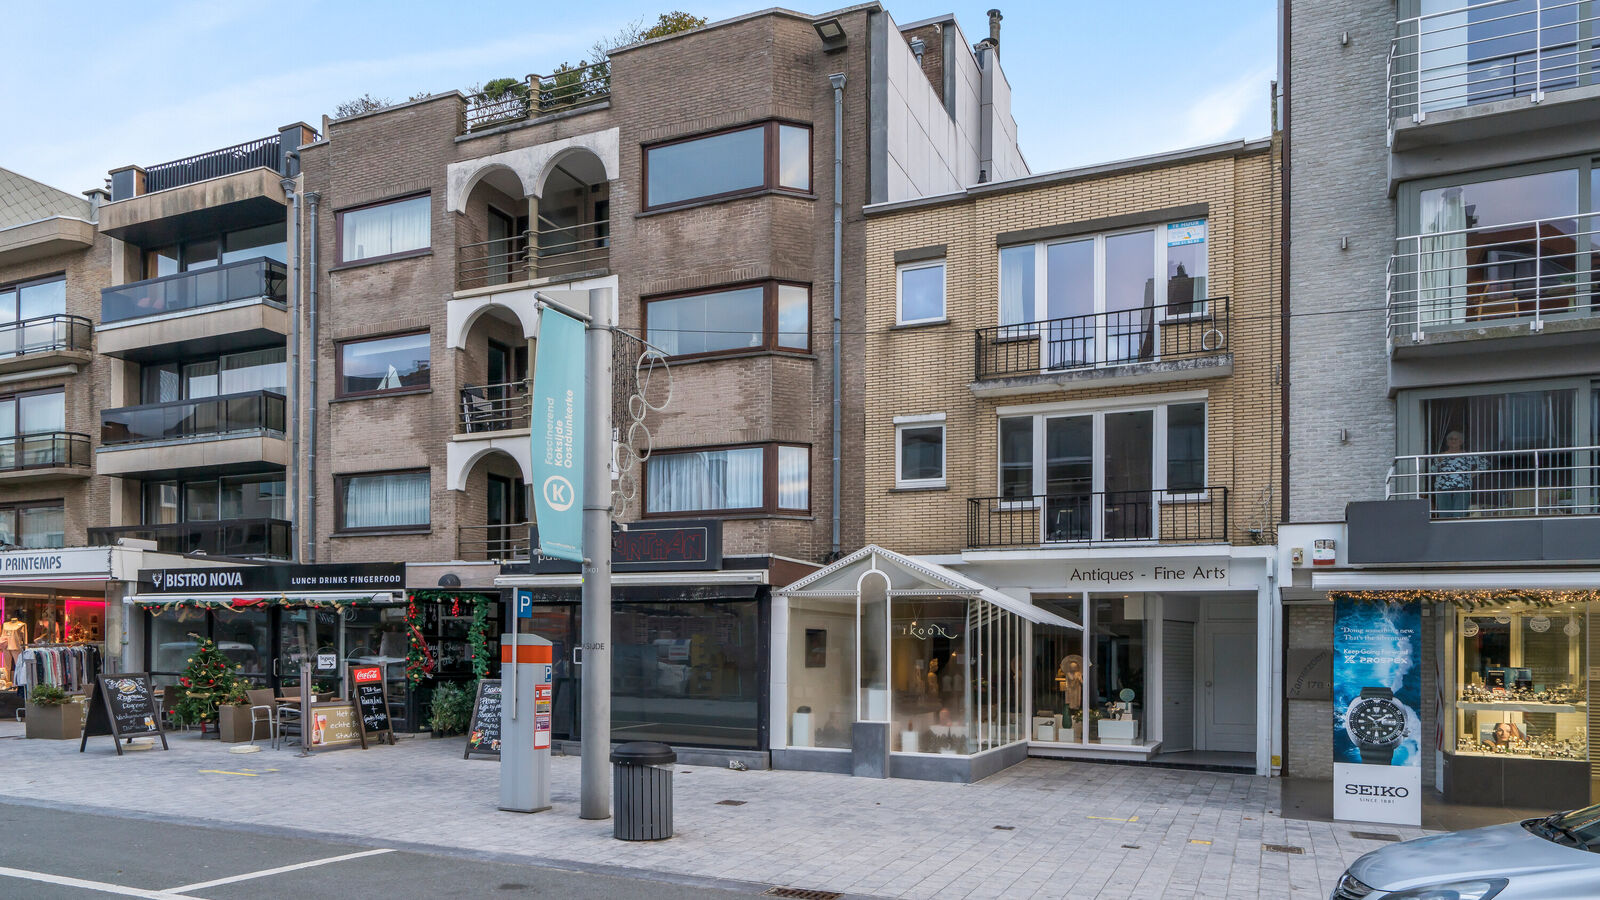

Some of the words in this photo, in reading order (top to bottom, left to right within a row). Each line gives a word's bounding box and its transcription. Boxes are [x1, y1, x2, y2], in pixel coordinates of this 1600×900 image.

[563, 389, 574, 469] Oostduinkerke
[553, 419, 565, 468] Koksijde
[552, 483, 566, 503] K
[5, 556, 62, 571] PRINTEMPS
[166, 573, 207, 587] BISTRO
[209, 572, 243, 586] NOVA
[291, 577, 317, 585] LUNCH
[319, 576, 348, 584] DRINKS
[350, 575, 401, 584] FINGERFOOD
[1070, 568, 1134, 584] Antiques
[1154, 566, 1186, 580] Fine
[1192, 566, 1226, 580] Arts
[520, 595, 531, 614] P
[1343, 648, 1360, 656] Keep
[1360, 648, 1382, 656] Going
[545, 666, 551, 679] P
[1345, 783, 1409, 798] SEIKO
